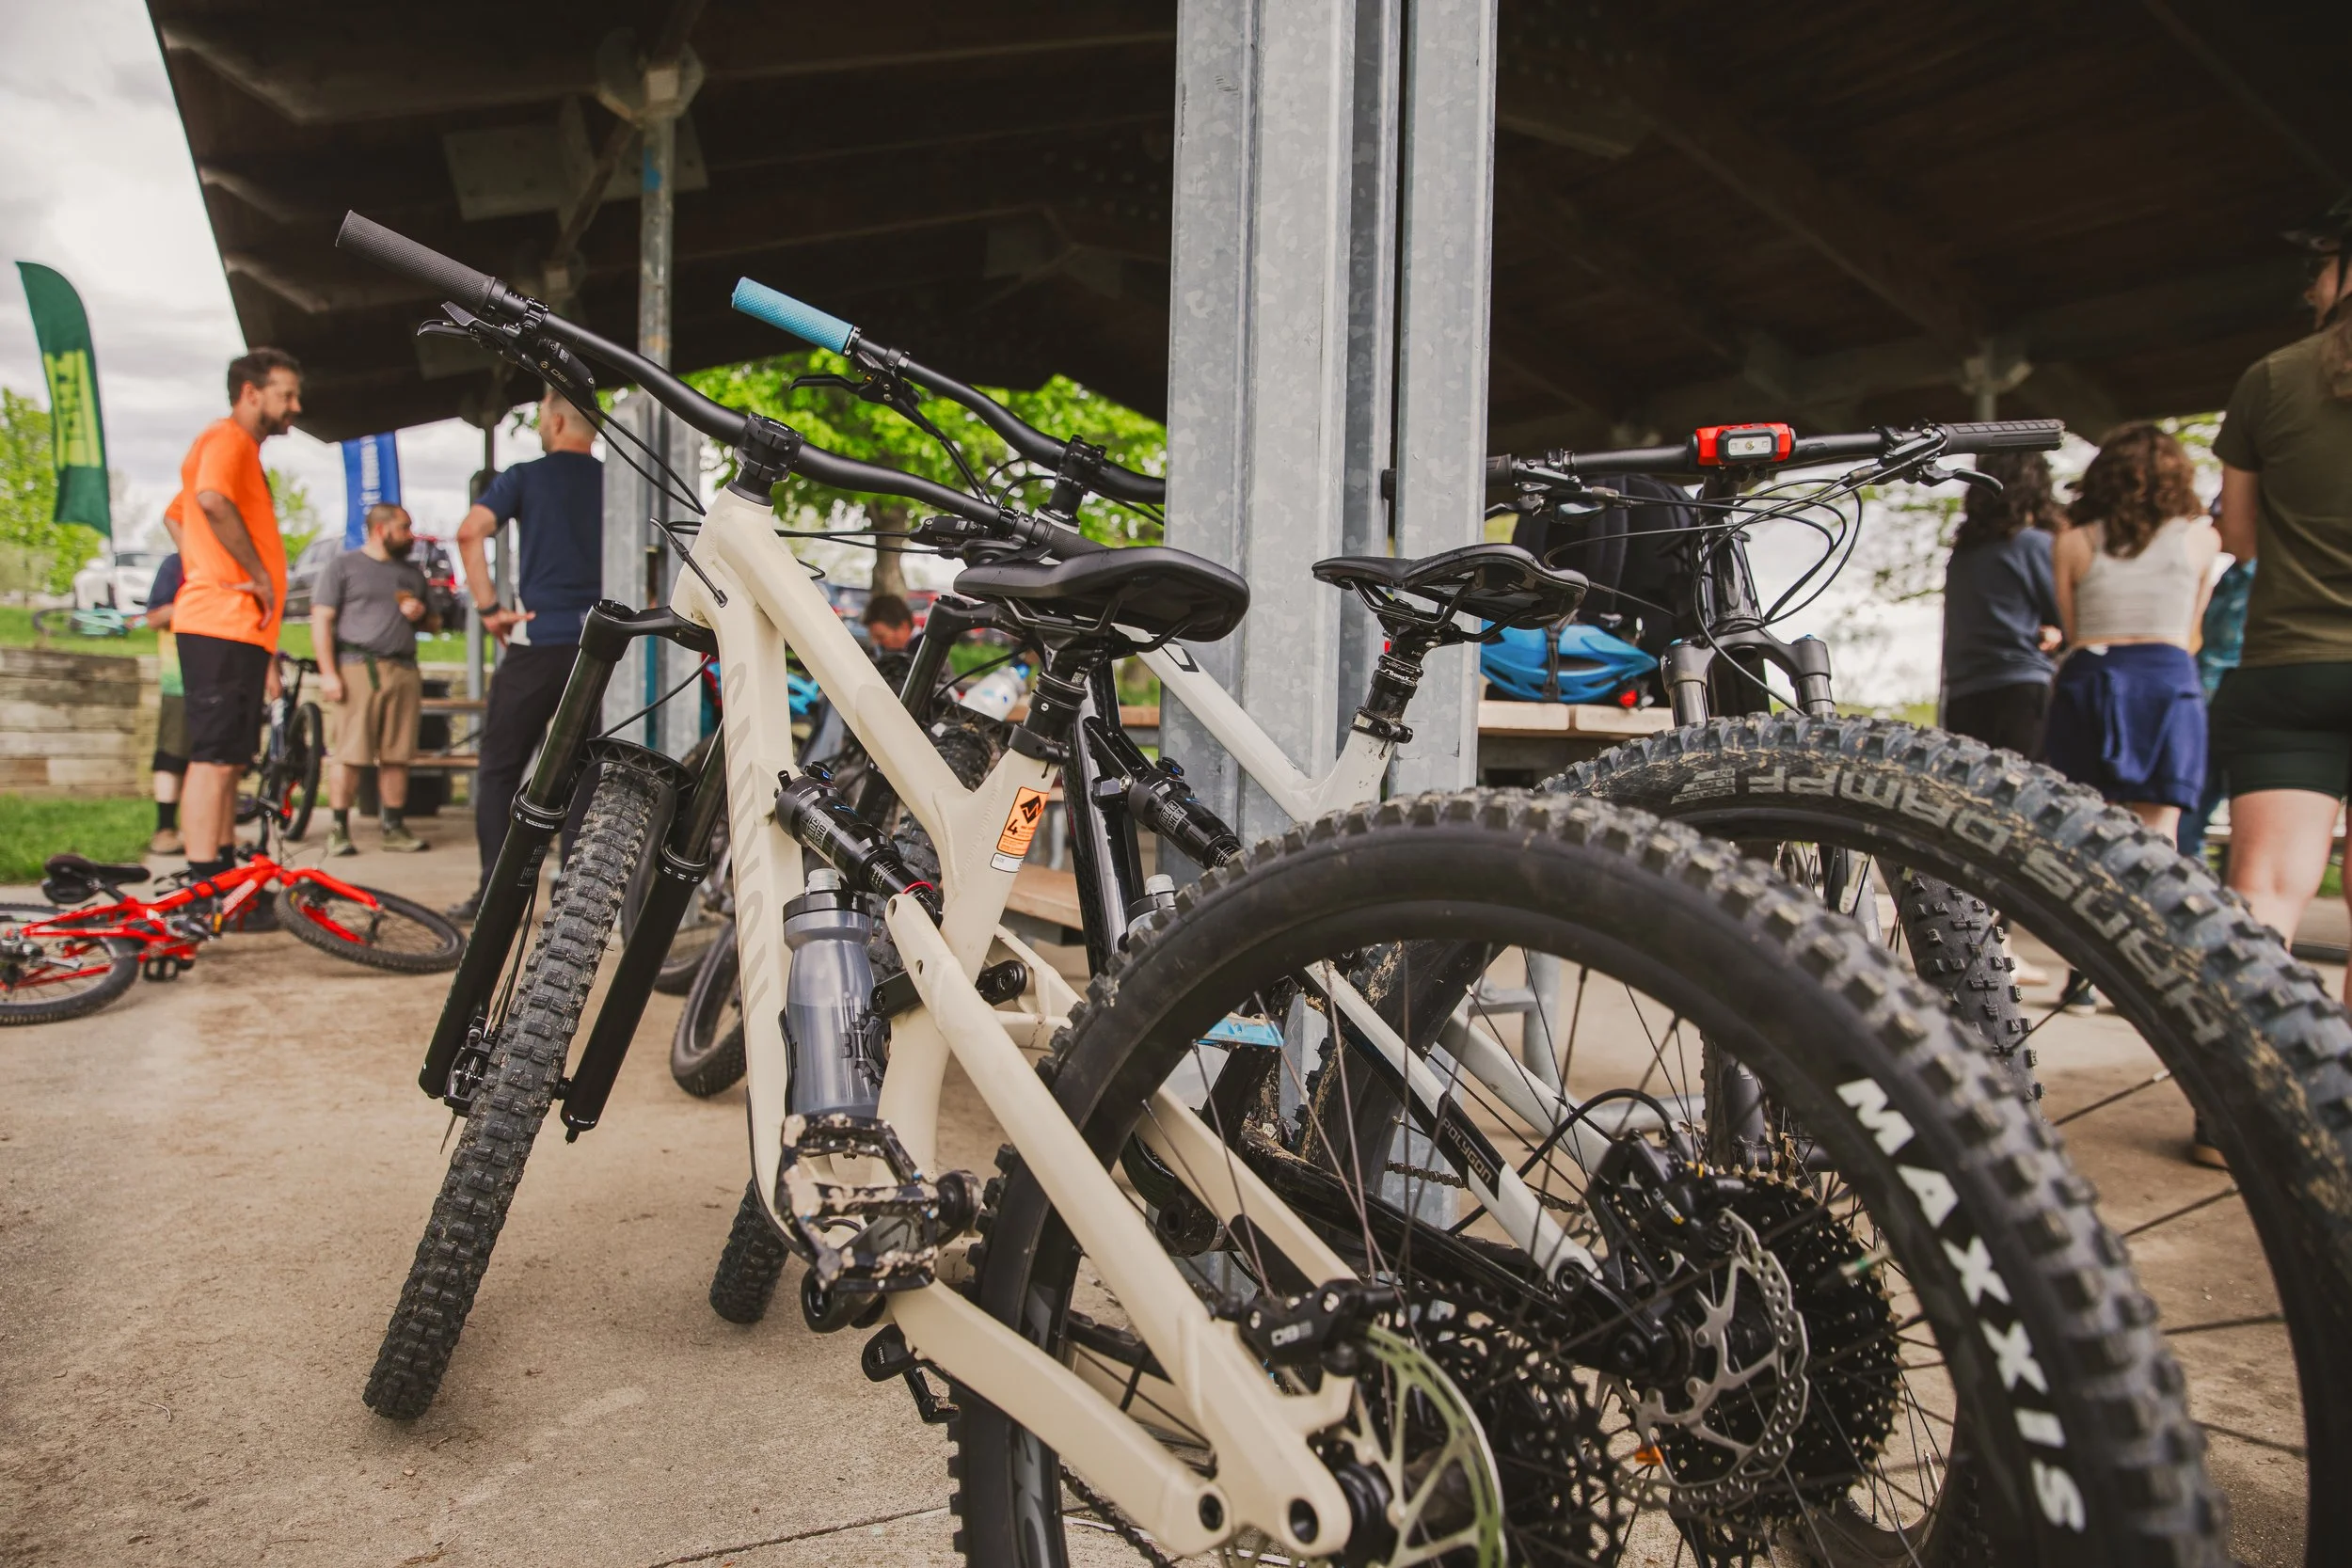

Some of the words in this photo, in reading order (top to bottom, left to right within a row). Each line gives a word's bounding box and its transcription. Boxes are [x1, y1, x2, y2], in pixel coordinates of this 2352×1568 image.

[1007, 818, 1019, 835] 4
[1747, 766, 2012, 854] DAMPF
[2020, 848, 2229, 1046] HANS
[840, 1032, 872, 1059] BIK
[1441, 1117, 1492, 1183] POLYGON
[1836, 1078, 2086, 1534] MAXXIS
